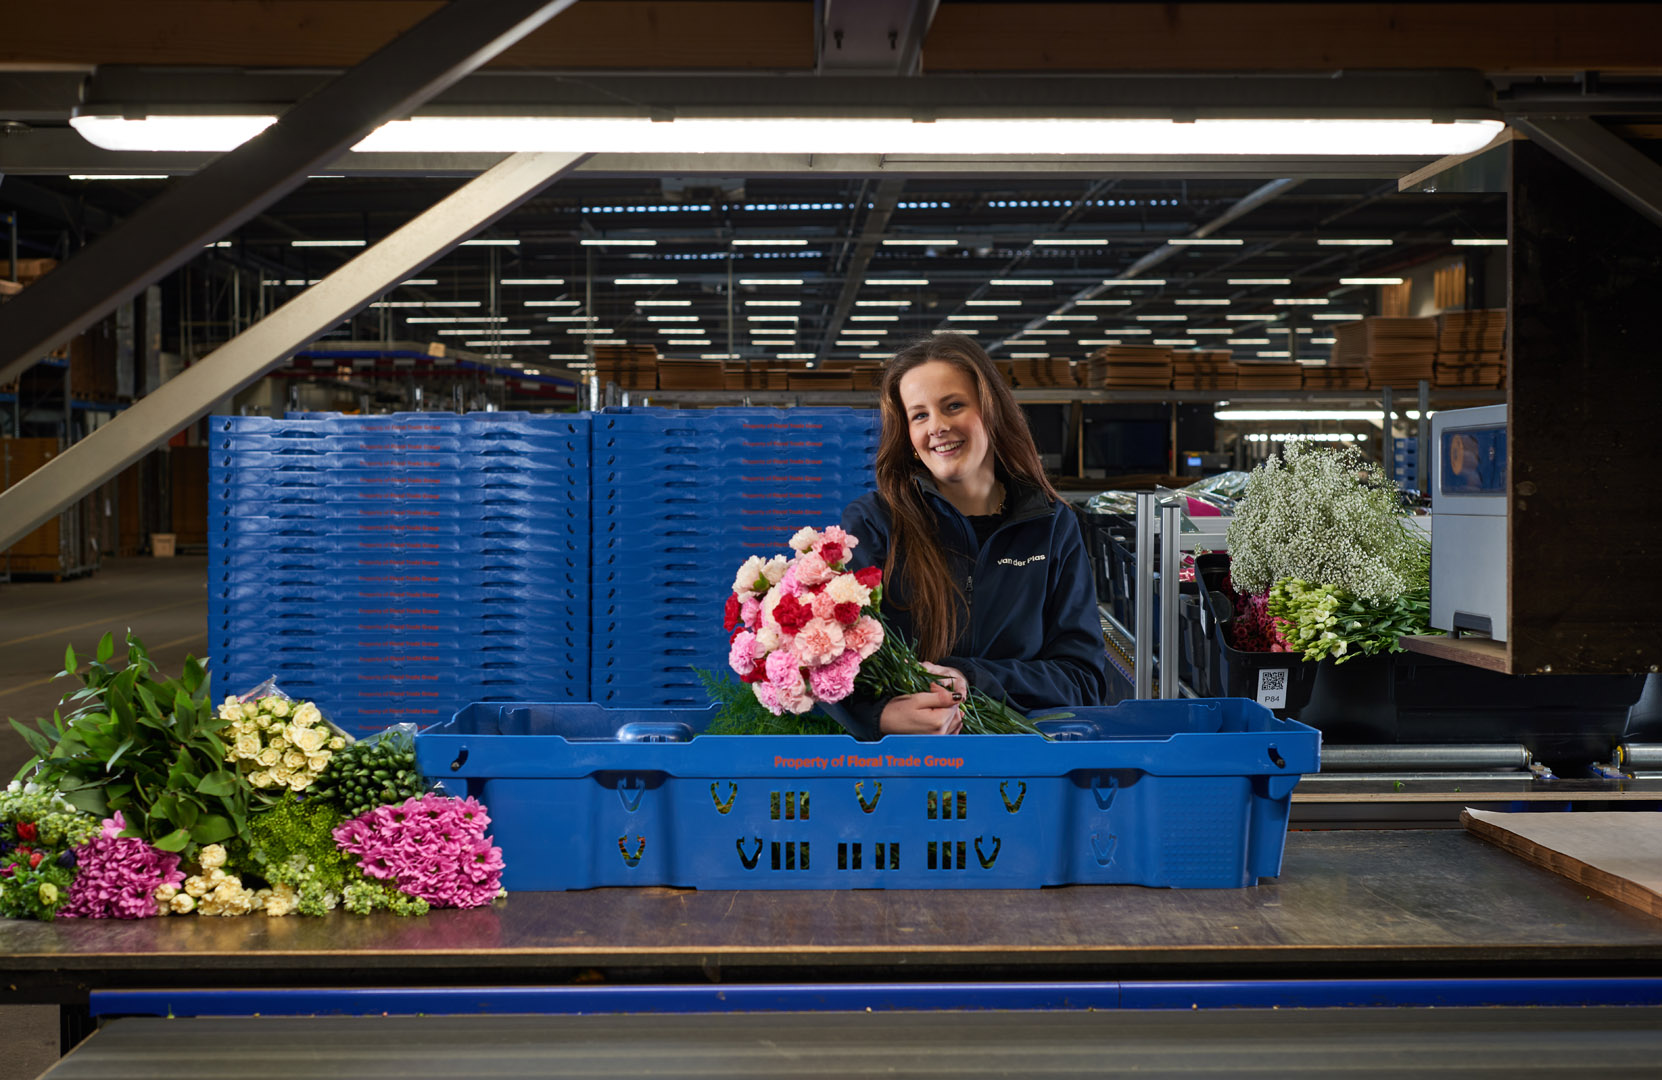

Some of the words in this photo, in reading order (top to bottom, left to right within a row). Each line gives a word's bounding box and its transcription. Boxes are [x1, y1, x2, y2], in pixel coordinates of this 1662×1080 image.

[774, 755, 829, 770] Property
[831, 754, 845, 767] of
[847, 754, 883, 767] Floral
[885, 754, 921, 767] Trade
[924, 755, 965, 769] Group
